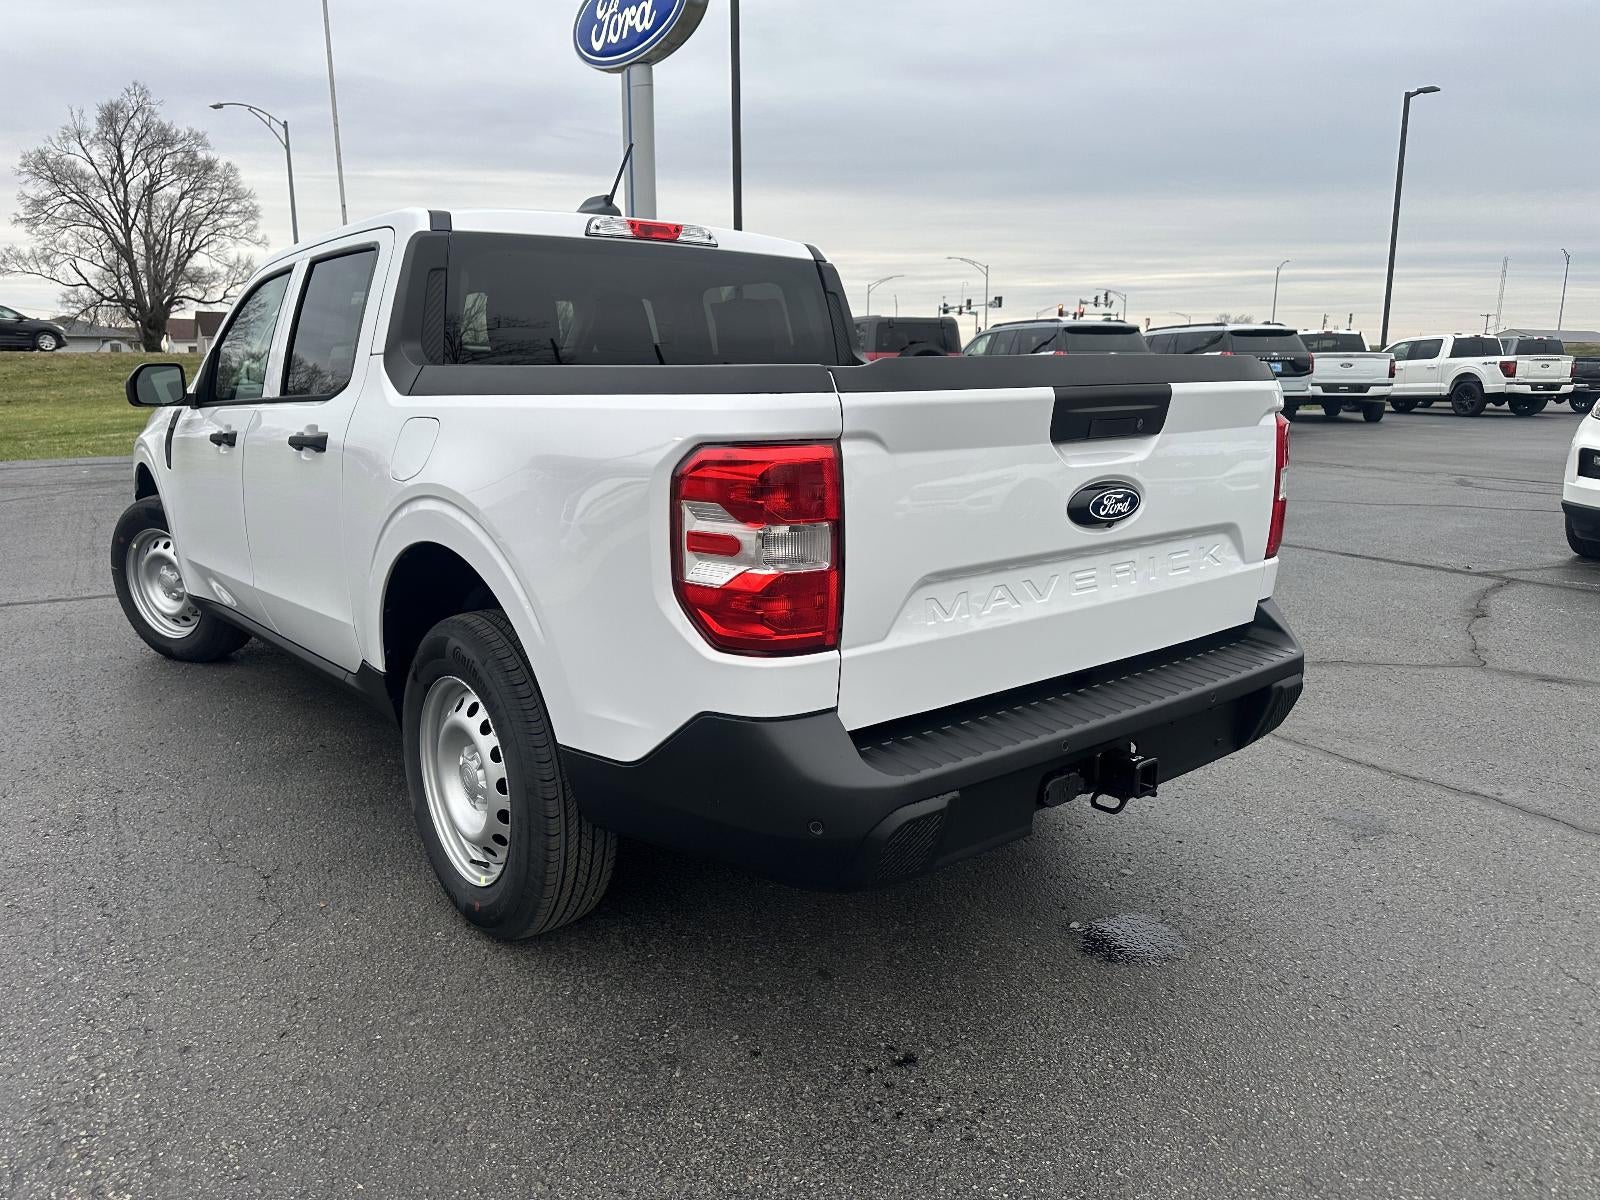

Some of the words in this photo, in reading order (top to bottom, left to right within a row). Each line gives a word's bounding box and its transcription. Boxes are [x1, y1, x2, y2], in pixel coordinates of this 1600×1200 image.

[591, 0, 657, 51] Ford
[1100, 494, 1131, 516] Ford
[925, 543, 1223, 625] MAVERICK
